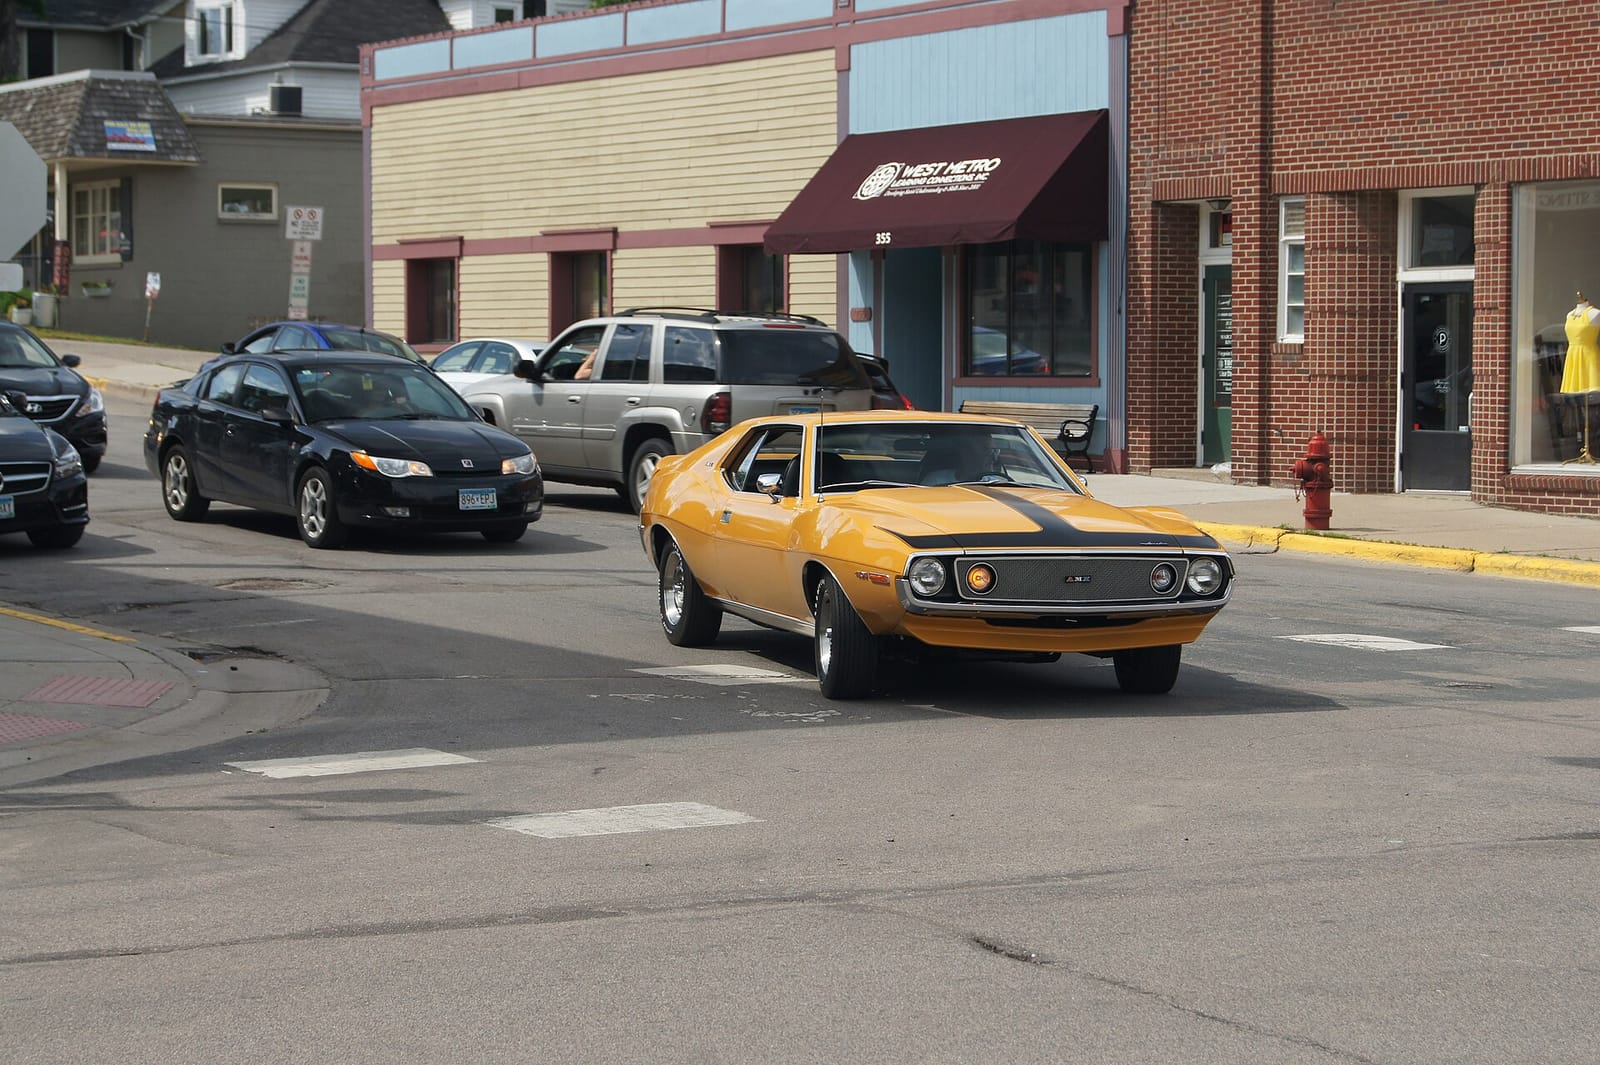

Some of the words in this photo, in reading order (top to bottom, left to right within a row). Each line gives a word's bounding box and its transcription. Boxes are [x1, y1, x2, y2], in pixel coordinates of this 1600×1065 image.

[903, 162, 947, 178] WEST
[943, 158, 1001, 175] METRO
[926, 173, 976, 185] CONNECTIONS
[875, 232, 892, 244] 355
